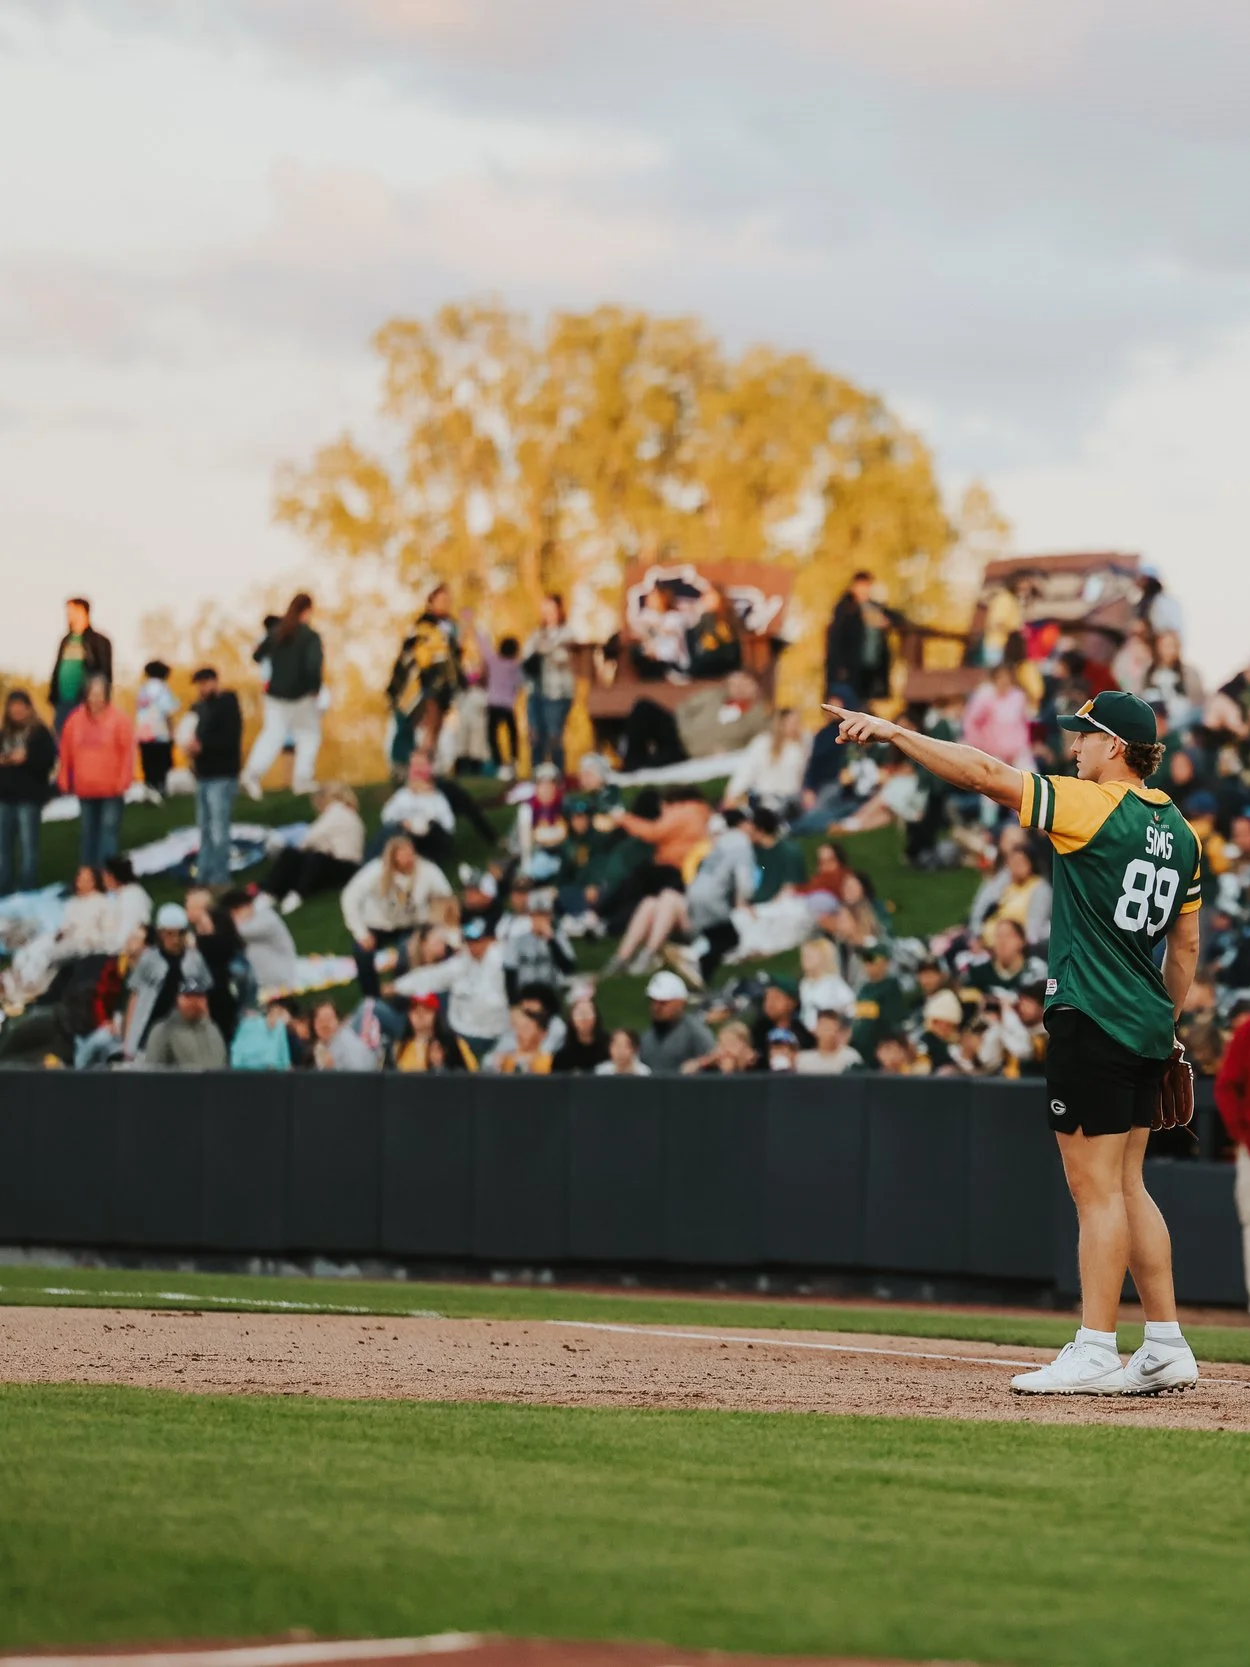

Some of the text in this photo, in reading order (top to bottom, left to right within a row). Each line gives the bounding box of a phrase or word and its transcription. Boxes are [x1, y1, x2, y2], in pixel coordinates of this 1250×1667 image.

[1145, 825, 1174, 860] SIMS
[1113, 858, 1180, 937] 89
[1050, 1098, 1067, 1116] G
